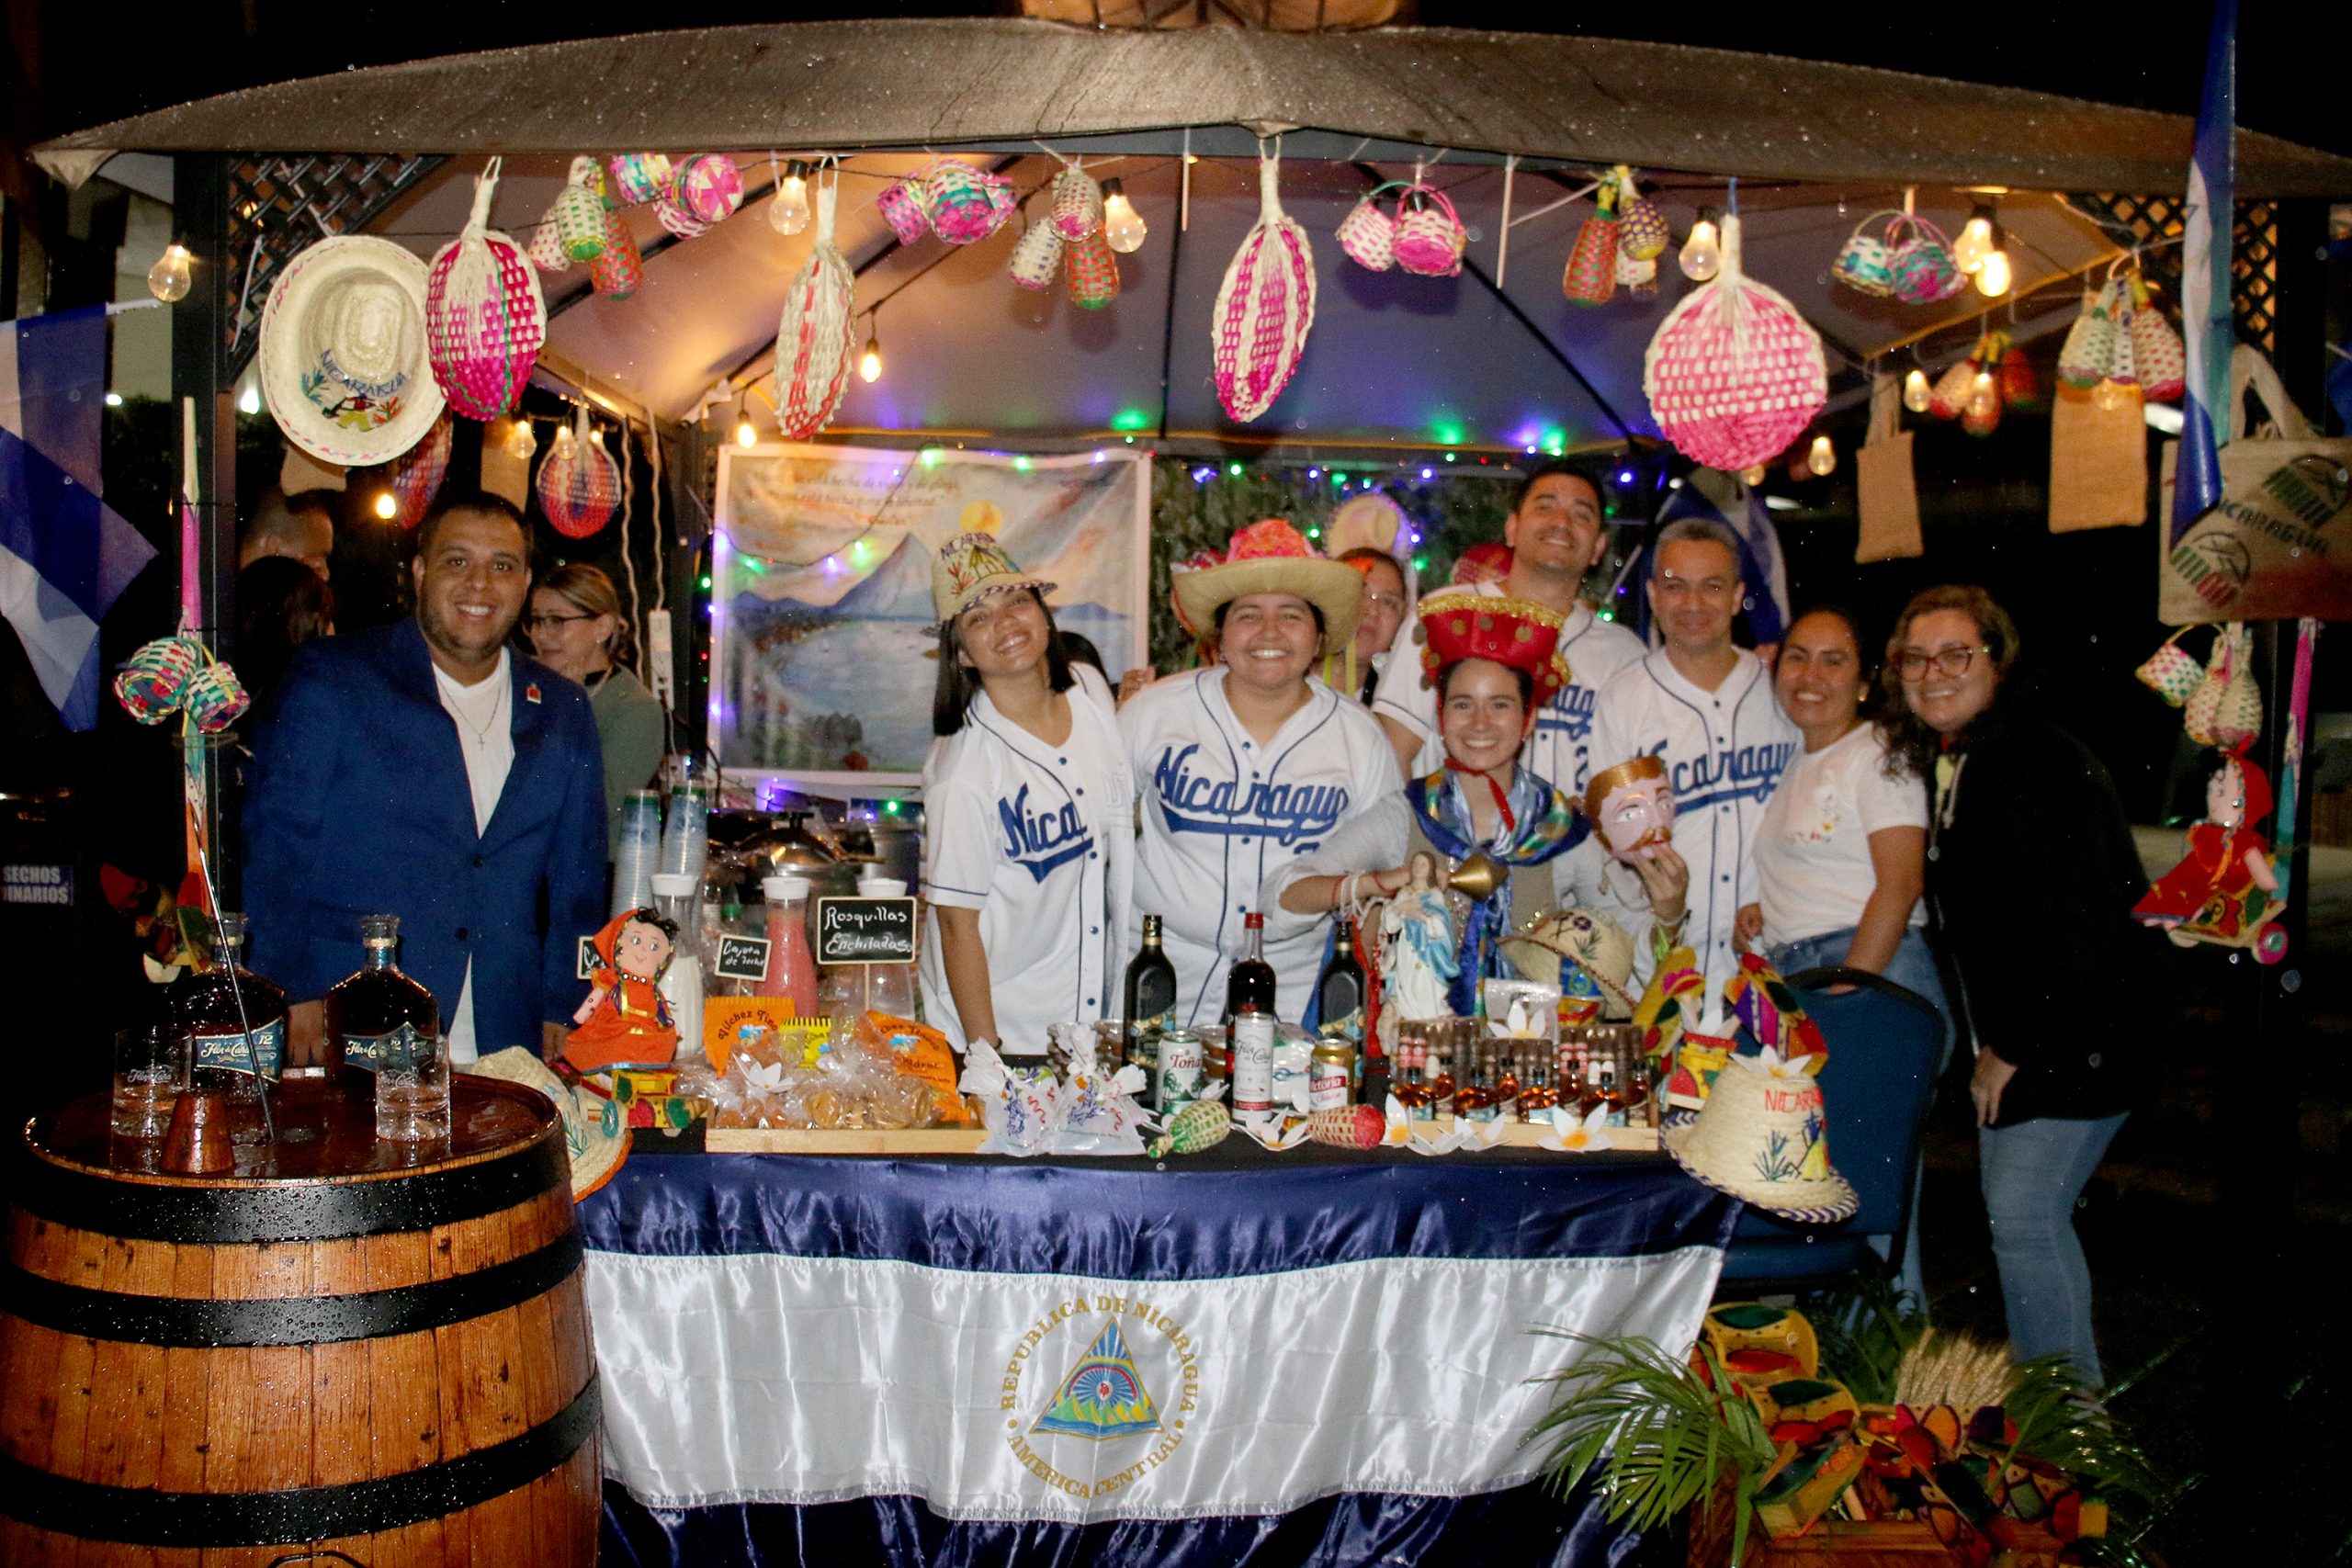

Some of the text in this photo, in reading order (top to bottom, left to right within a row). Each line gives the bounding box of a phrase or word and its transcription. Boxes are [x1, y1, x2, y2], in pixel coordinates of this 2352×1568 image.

[824, 906, 908, 931] Rosquillas
[825, 932, 910, 954] Enchiladas
[725, 955, 738, 965] de
[757, 1010, 778, 1031] Tino
[258, 1034, 273, 1045] 12
[1001, 1295, 1198, 1413] REPUBLICA DE NICARAGUA
[1008, 1433, 1183, 1499] AMERICA CENTRAL
